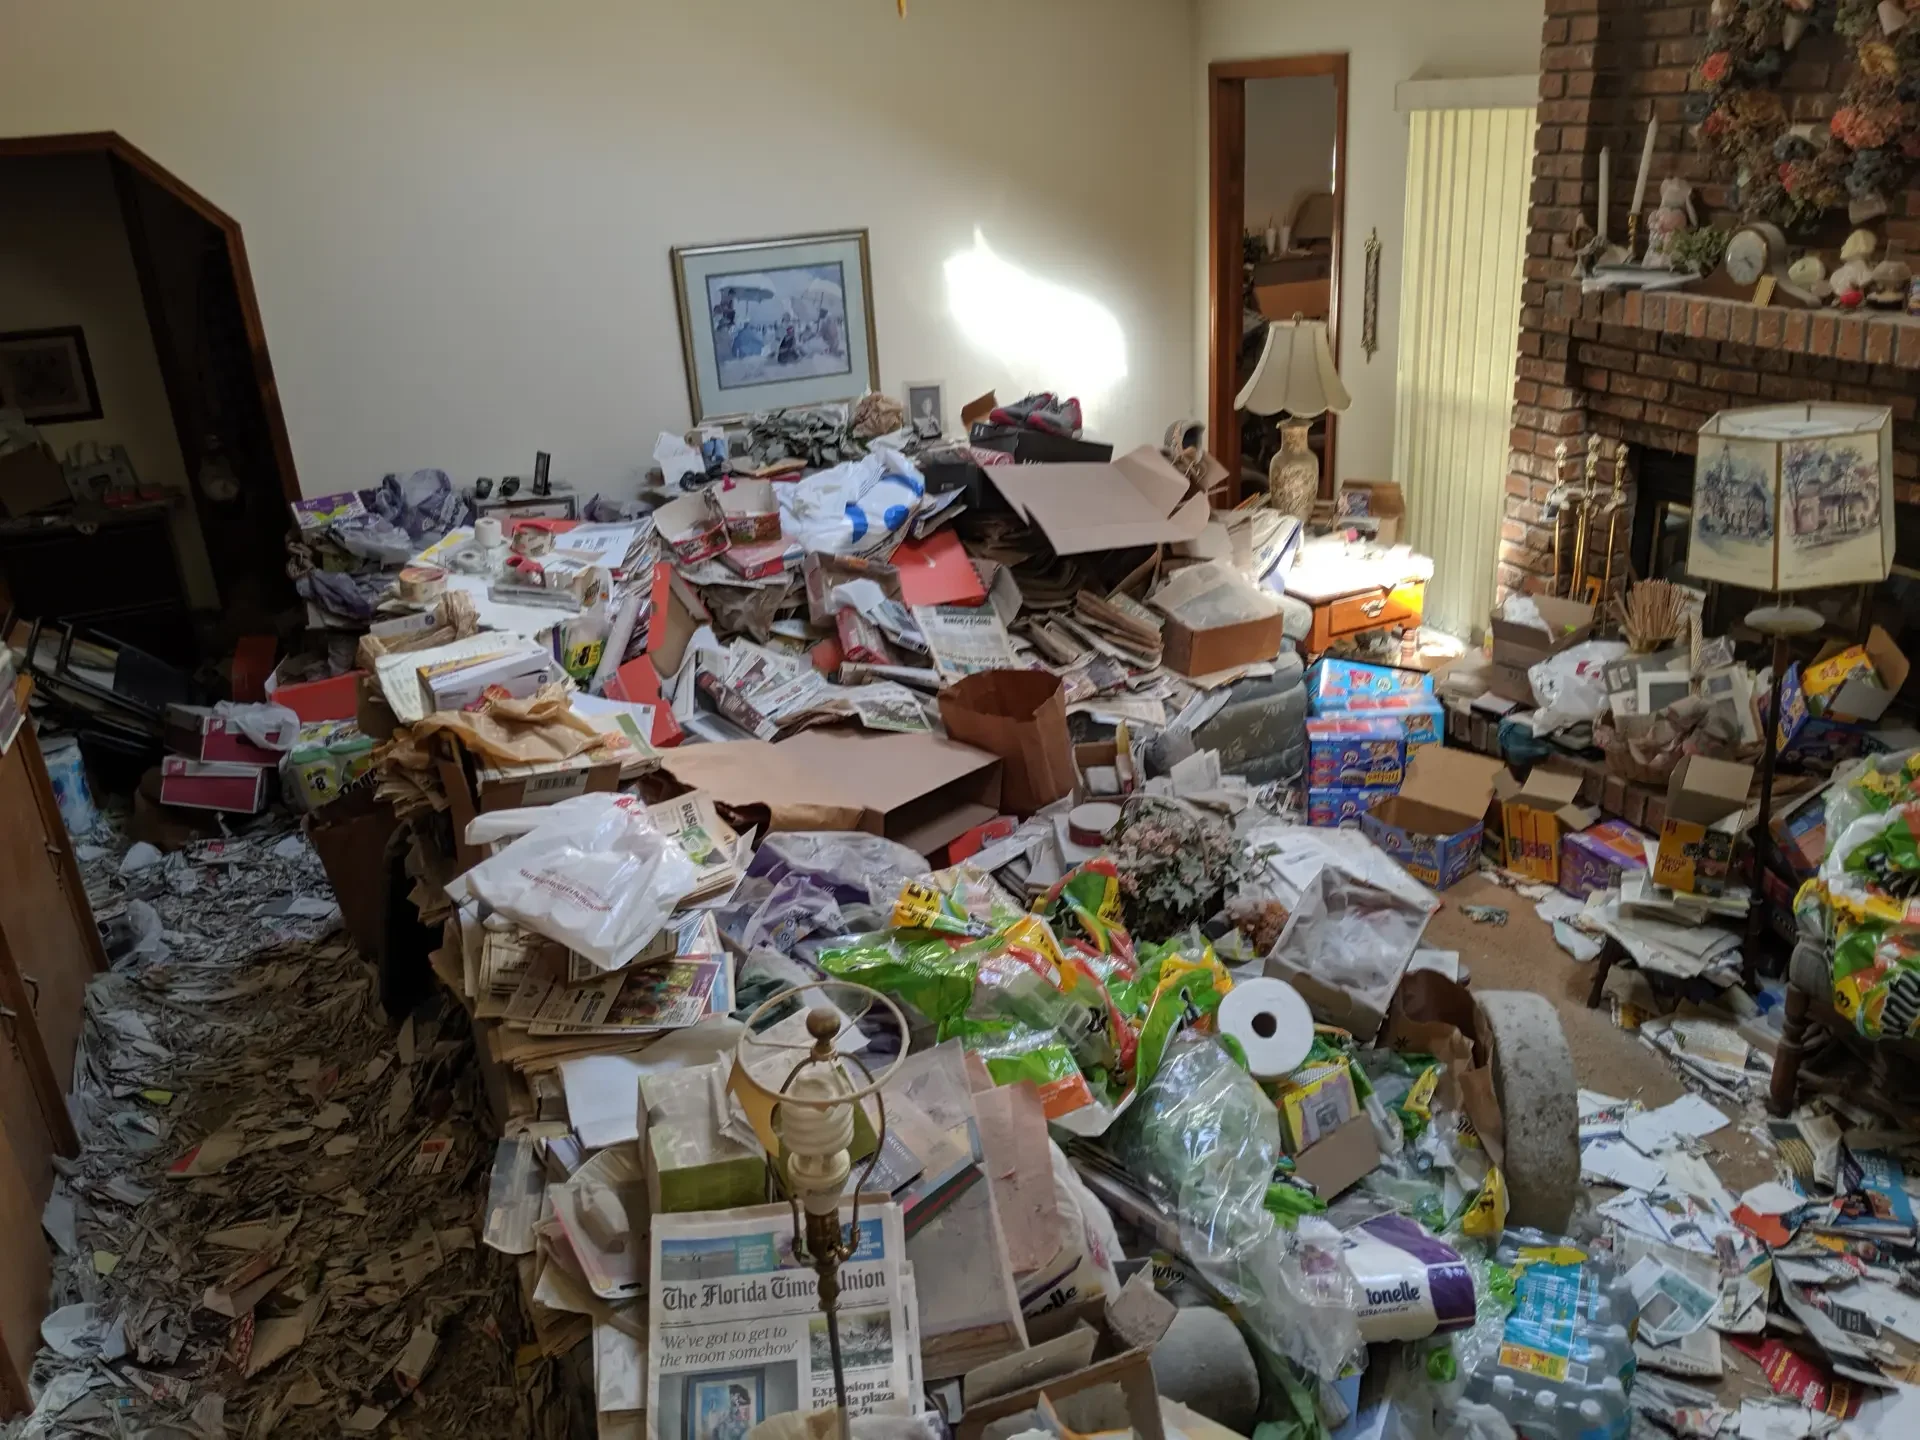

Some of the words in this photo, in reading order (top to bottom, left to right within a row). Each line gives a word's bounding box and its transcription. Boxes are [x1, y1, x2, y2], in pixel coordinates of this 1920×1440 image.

[662, 1287, 698, 1311] The
[700, 1279, 767, 1308] Florida
[770, 1276, 817, 1299] Time
[705, 1331, 728, 1349] got
[732, 1331, 746, 1343] to
[747, 1328, 769, 1345] get
[773, 1326, 788, 1339] to
[660, 1352, 682, 1368] the
[684, 1350, 725, 1365] moon
[812, 1381, 875, 1398] Expsion
[877, 1379, 890, 1389] at
[862, 1391, 895, 1407] plaza
